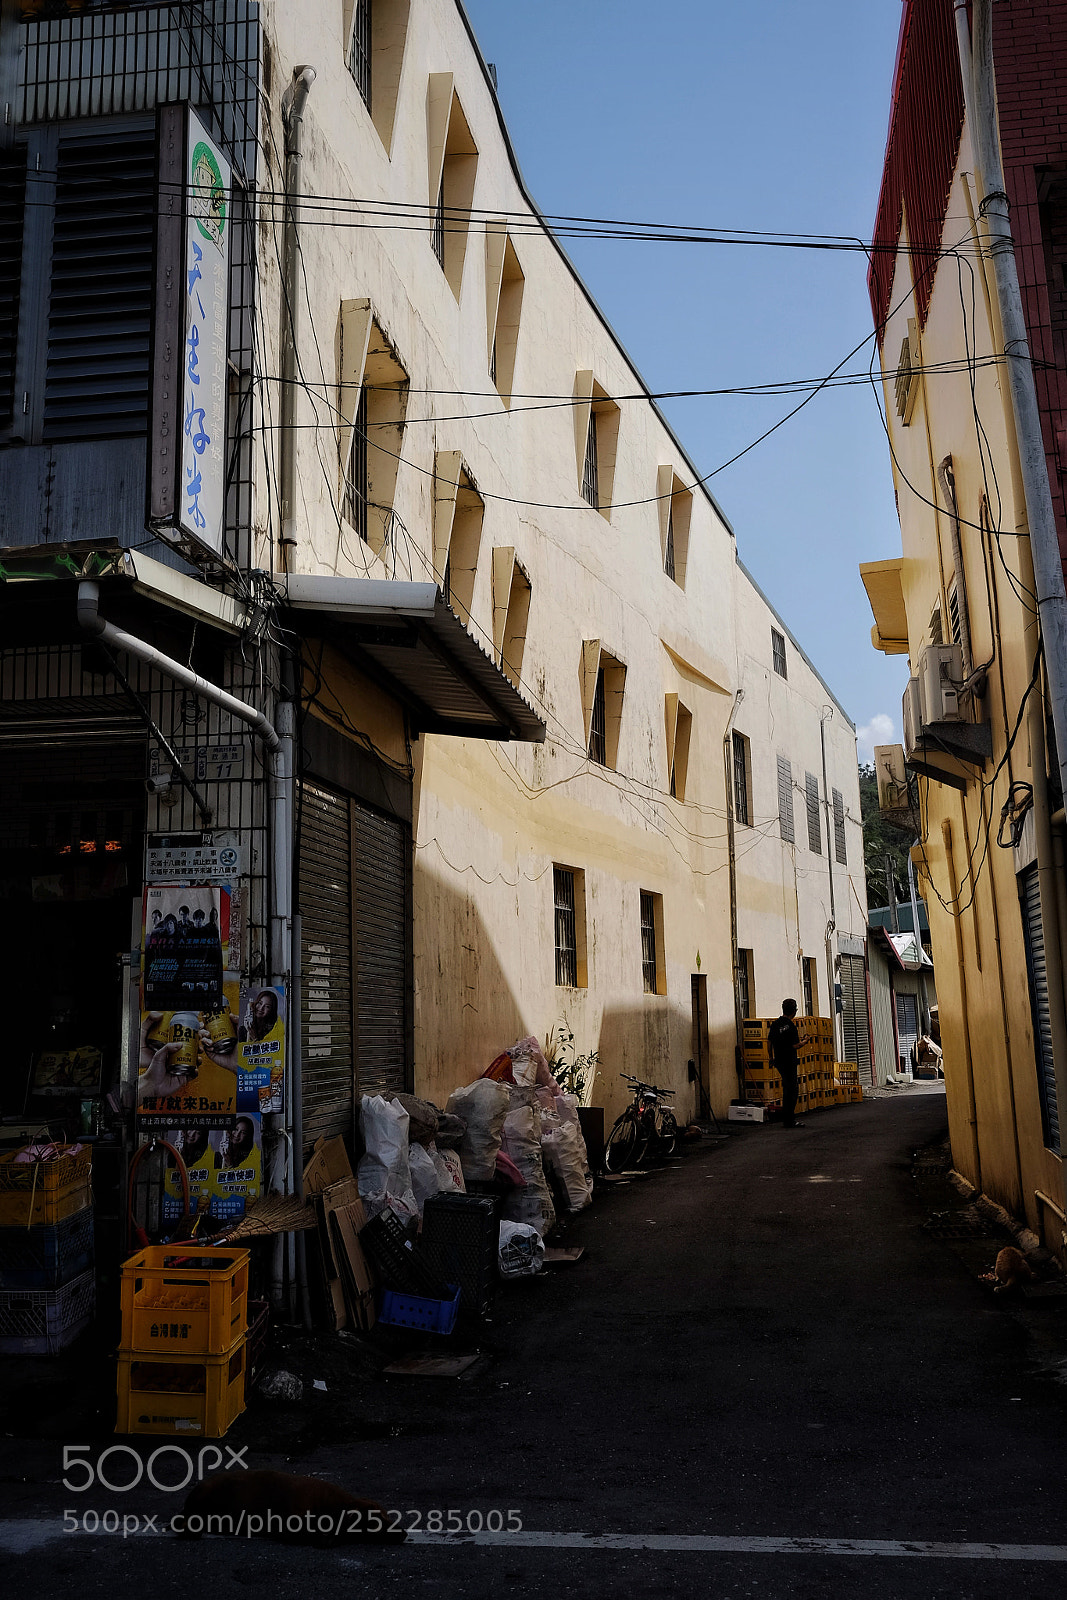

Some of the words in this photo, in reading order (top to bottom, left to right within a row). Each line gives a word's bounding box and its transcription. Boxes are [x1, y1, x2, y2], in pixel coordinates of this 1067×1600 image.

[216, 764, 233, 778] 11
[173, 1024, 199, 1039] Bar
[171, 1169, 209, 1183] 啟快樂
